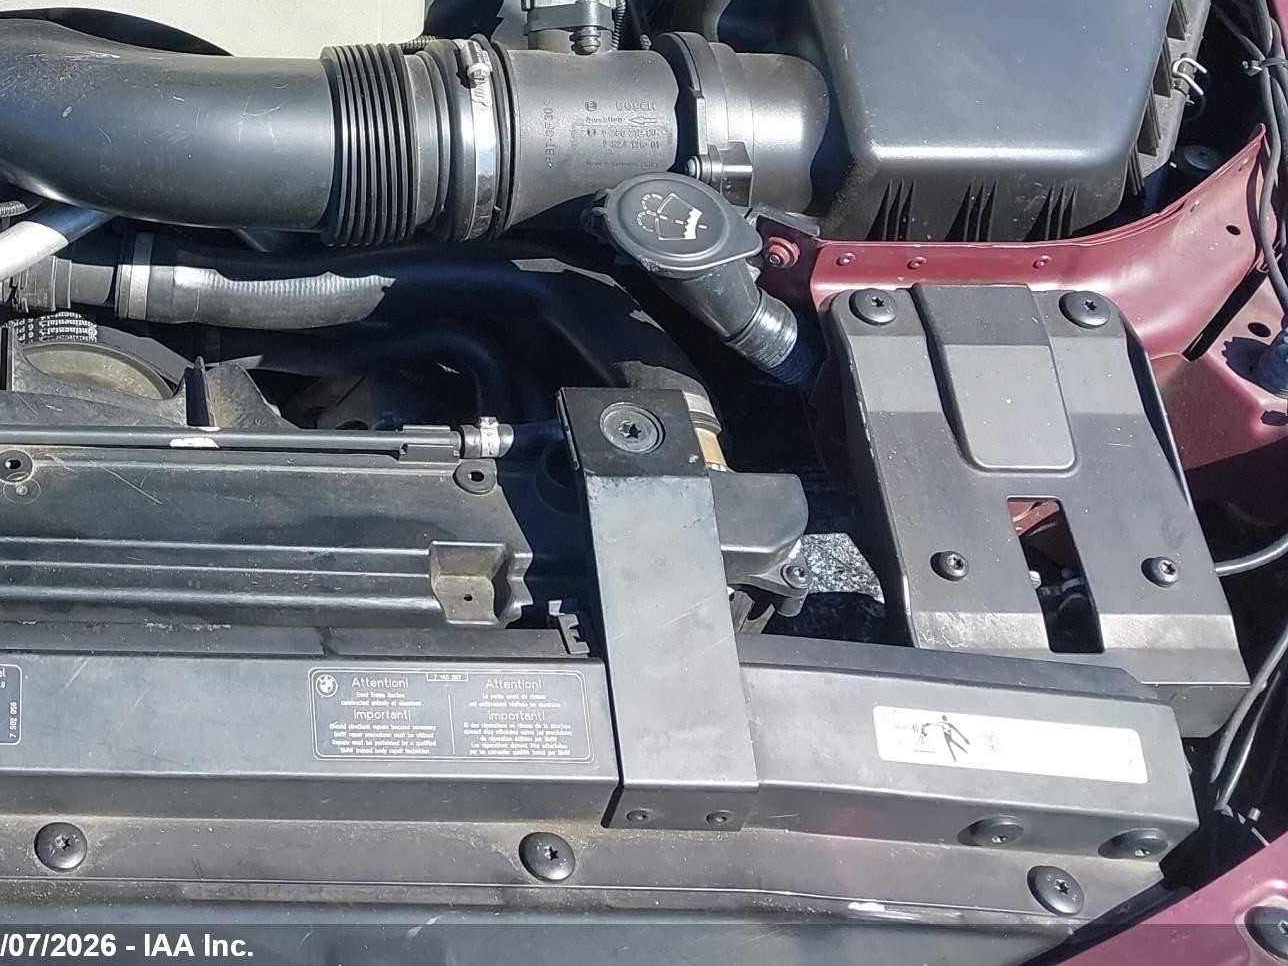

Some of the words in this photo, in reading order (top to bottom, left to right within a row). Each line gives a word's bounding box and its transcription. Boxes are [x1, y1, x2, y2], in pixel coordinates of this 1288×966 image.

[352, 677, 408, 688] Attention!
[486, 679, 541, 690] Attention!
[353, 710, 411, 720] Important!
[488, 711, 545, 721] Important!
